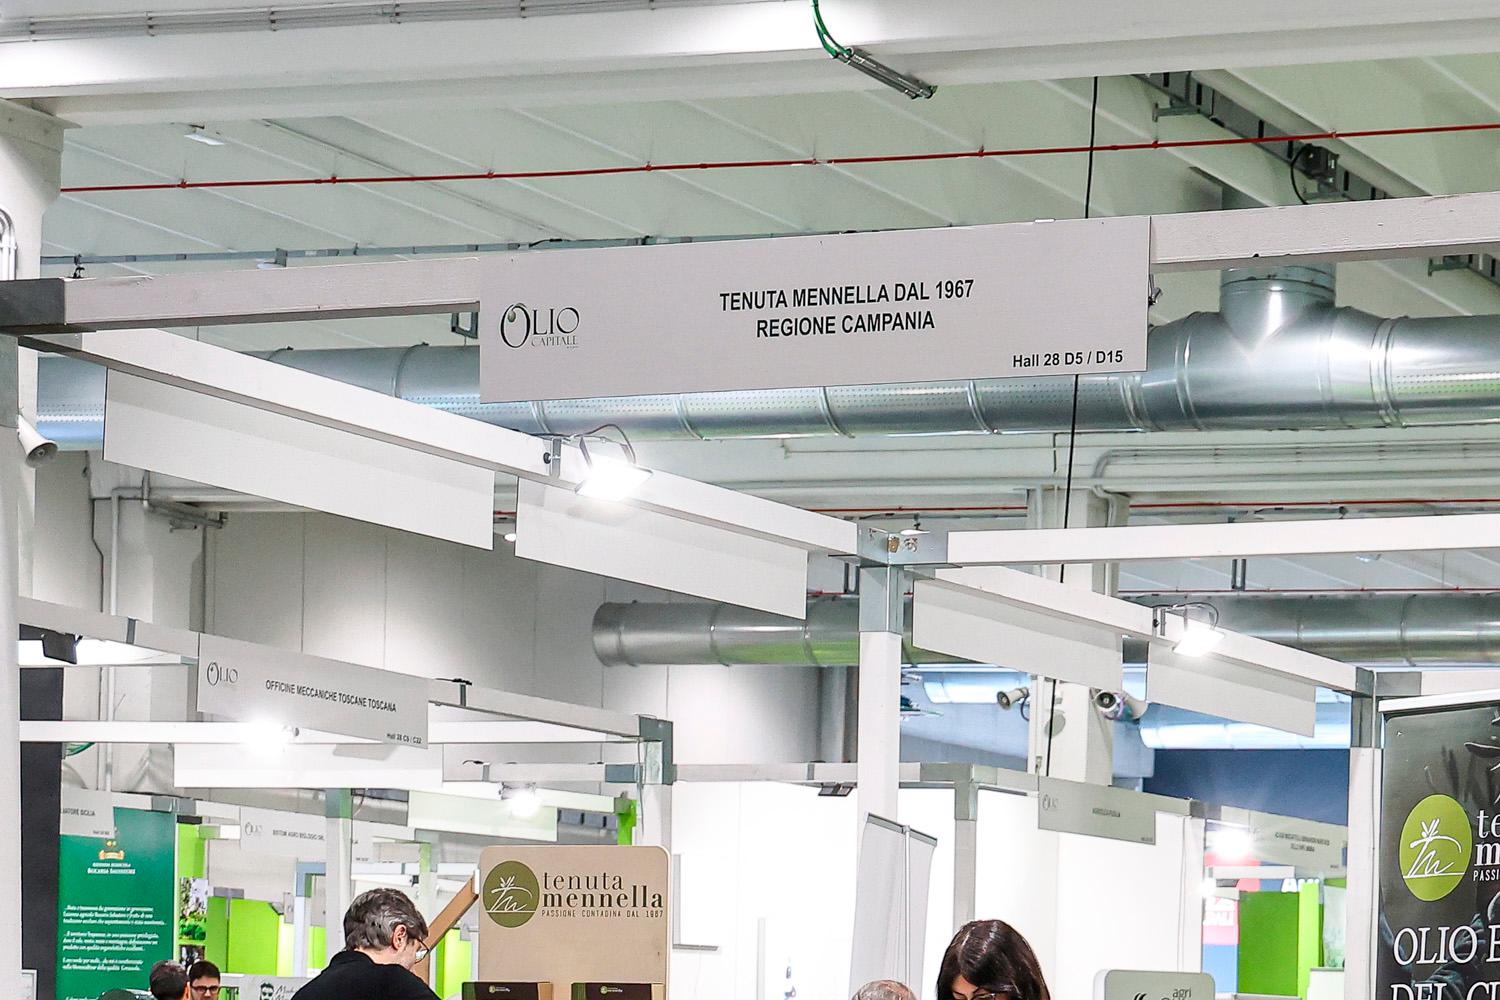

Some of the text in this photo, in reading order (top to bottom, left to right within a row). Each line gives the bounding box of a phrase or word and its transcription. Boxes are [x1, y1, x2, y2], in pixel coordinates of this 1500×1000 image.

[719, 279, 974, 312] TENUTA MENNELLA DAL 1967
[500, 303, 580, 348] OLIO
[756, 310, 935, 338] REGIONE CAMPANIA
[530, 334, 579, 348] CAPITALE
[1012, 349, 1123, 368] Hall 28 D5 / D15
[265, 679, 397, 713] OFFICINE MECCANICHE TOSCANE TOSCANA
[543, 872, 624, 890] tenuta
[541, 885, 663, 908] mennella
[541, 909, 576, 918] PASSIONE
[581, 909, 622, 918] CONTADINA
[626, 909, 639, 918] DAL
[1392, 927, 1478, 966] OLIO
[1172, 986, 1192, 1000] agri
